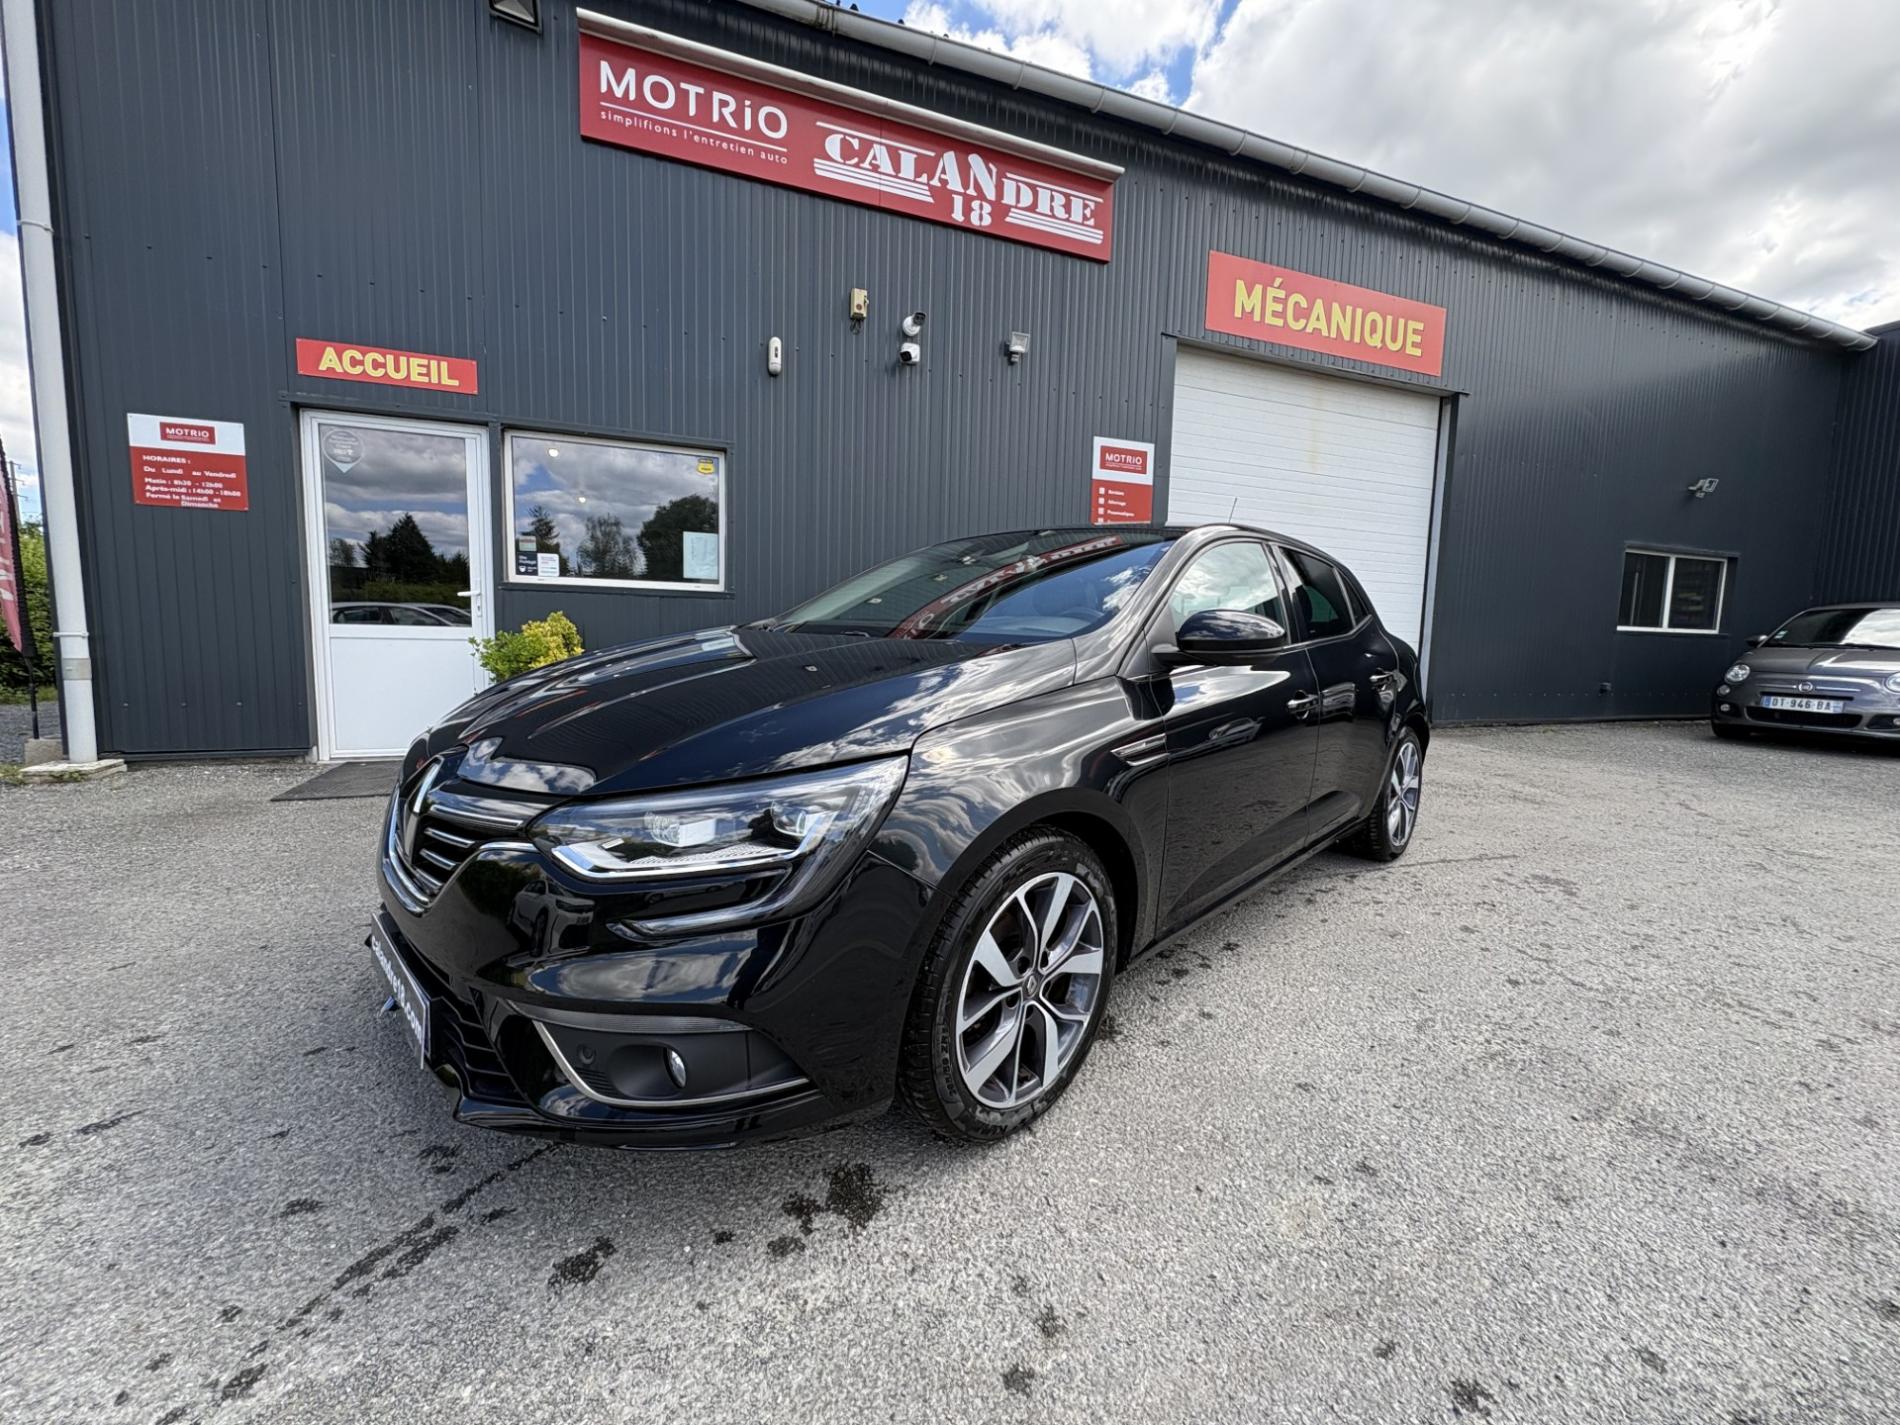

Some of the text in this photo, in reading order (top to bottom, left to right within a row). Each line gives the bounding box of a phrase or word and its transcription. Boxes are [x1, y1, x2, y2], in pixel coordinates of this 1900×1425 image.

[600, 109, 788, 165] simplifions l'entretien auto
[825, 133, 1096, 226] CALANDRE
[951, 193, 992, 227] 18
[1233, 277, 1425, 357] MÉCANIQUE
[318, 346, 460, 387] ACCUEIL
